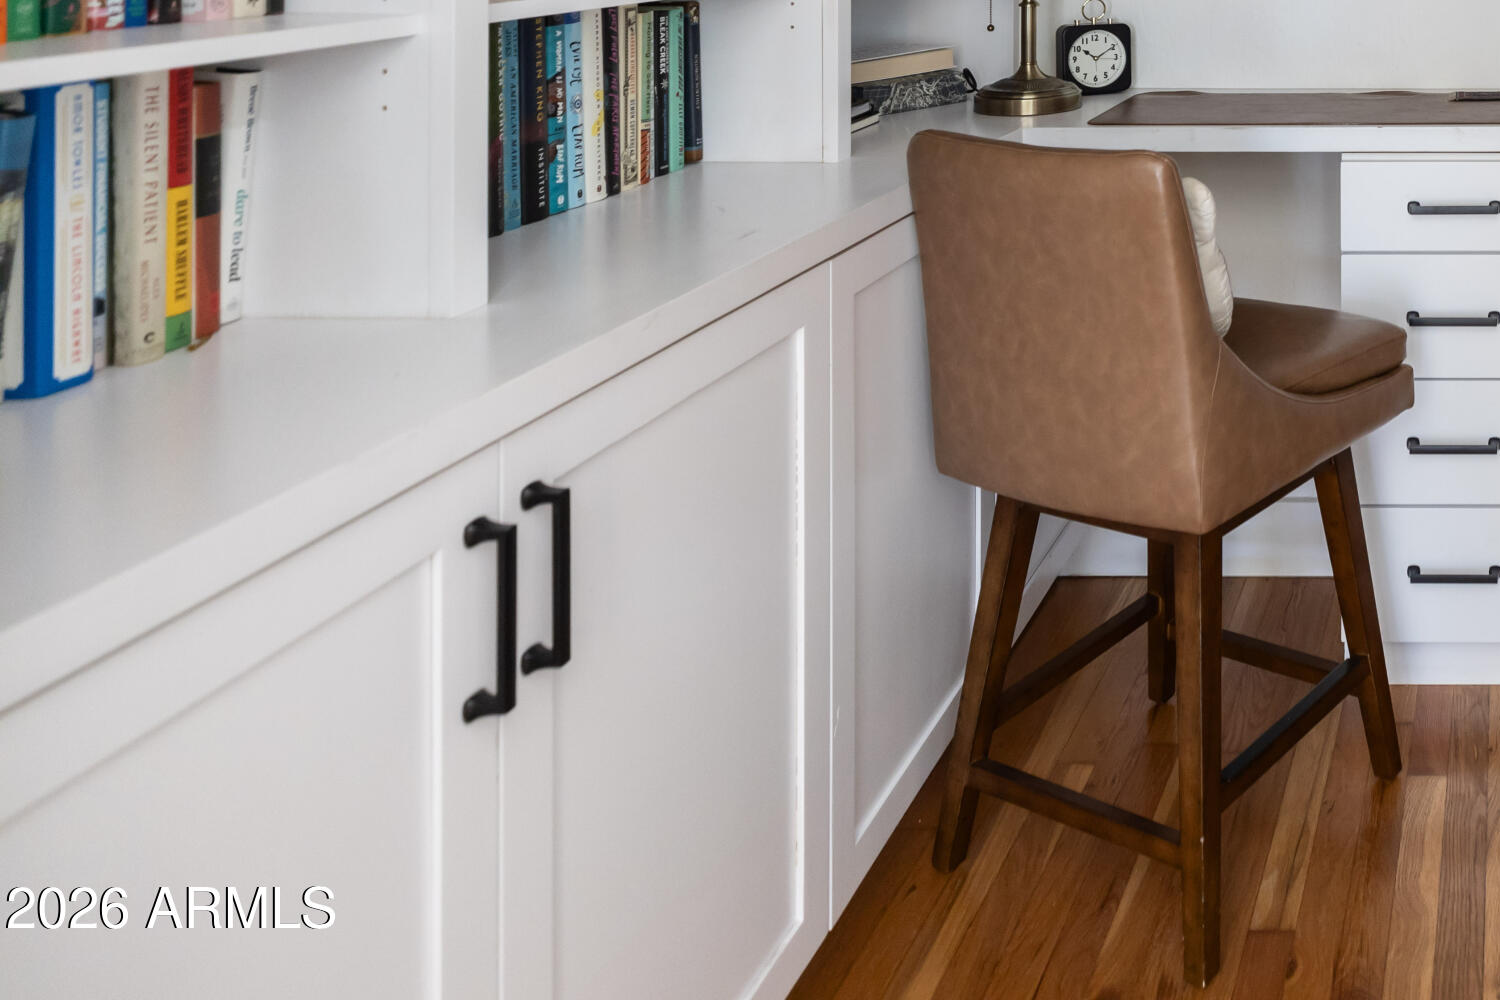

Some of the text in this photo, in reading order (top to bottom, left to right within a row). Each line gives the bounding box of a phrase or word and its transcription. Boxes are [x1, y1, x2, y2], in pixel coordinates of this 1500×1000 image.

[1091, 34, 1099, 42] 12
[510, 66, 517, 79] AN
[536, 87, 544, 122] KING
[608, 94, 618, 121] PARIS
[73, 140, 84, 189] TOWLES
[144, 85, 159, 244] THE SILENT PATIENT
[175, 200, 187, 300] HARLEM SHUFFLE
[228, 189, 248, 282] dare to lead
